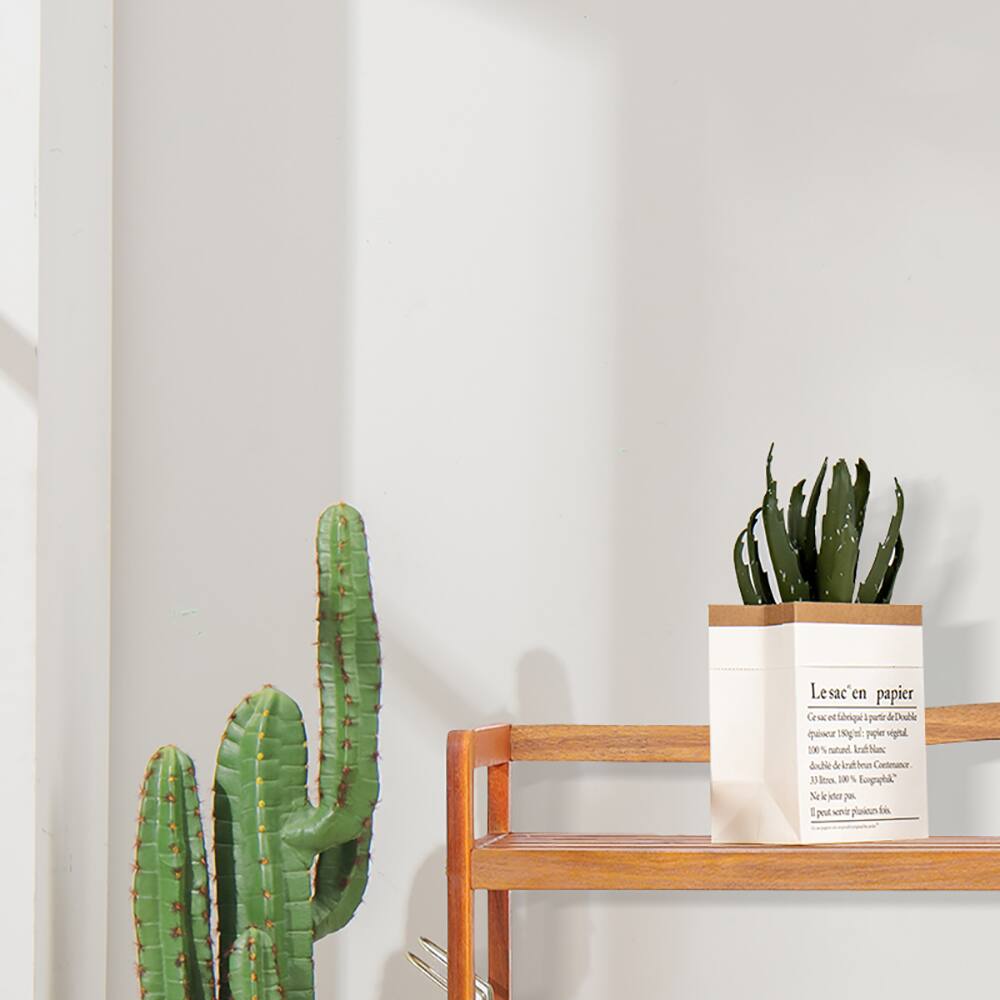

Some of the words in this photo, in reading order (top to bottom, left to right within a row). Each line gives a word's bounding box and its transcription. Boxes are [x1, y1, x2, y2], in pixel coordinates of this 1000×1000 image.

[811, 682, 827, 700] Le
[852, 688, 867, 700] en
[876, 685, 914, 706] papier
[807, 712, 817, 722] Ce
[886, 711, 895, 722] de
[895, 712, 918, 722] Double
[838, 775, 849, 784] 100
